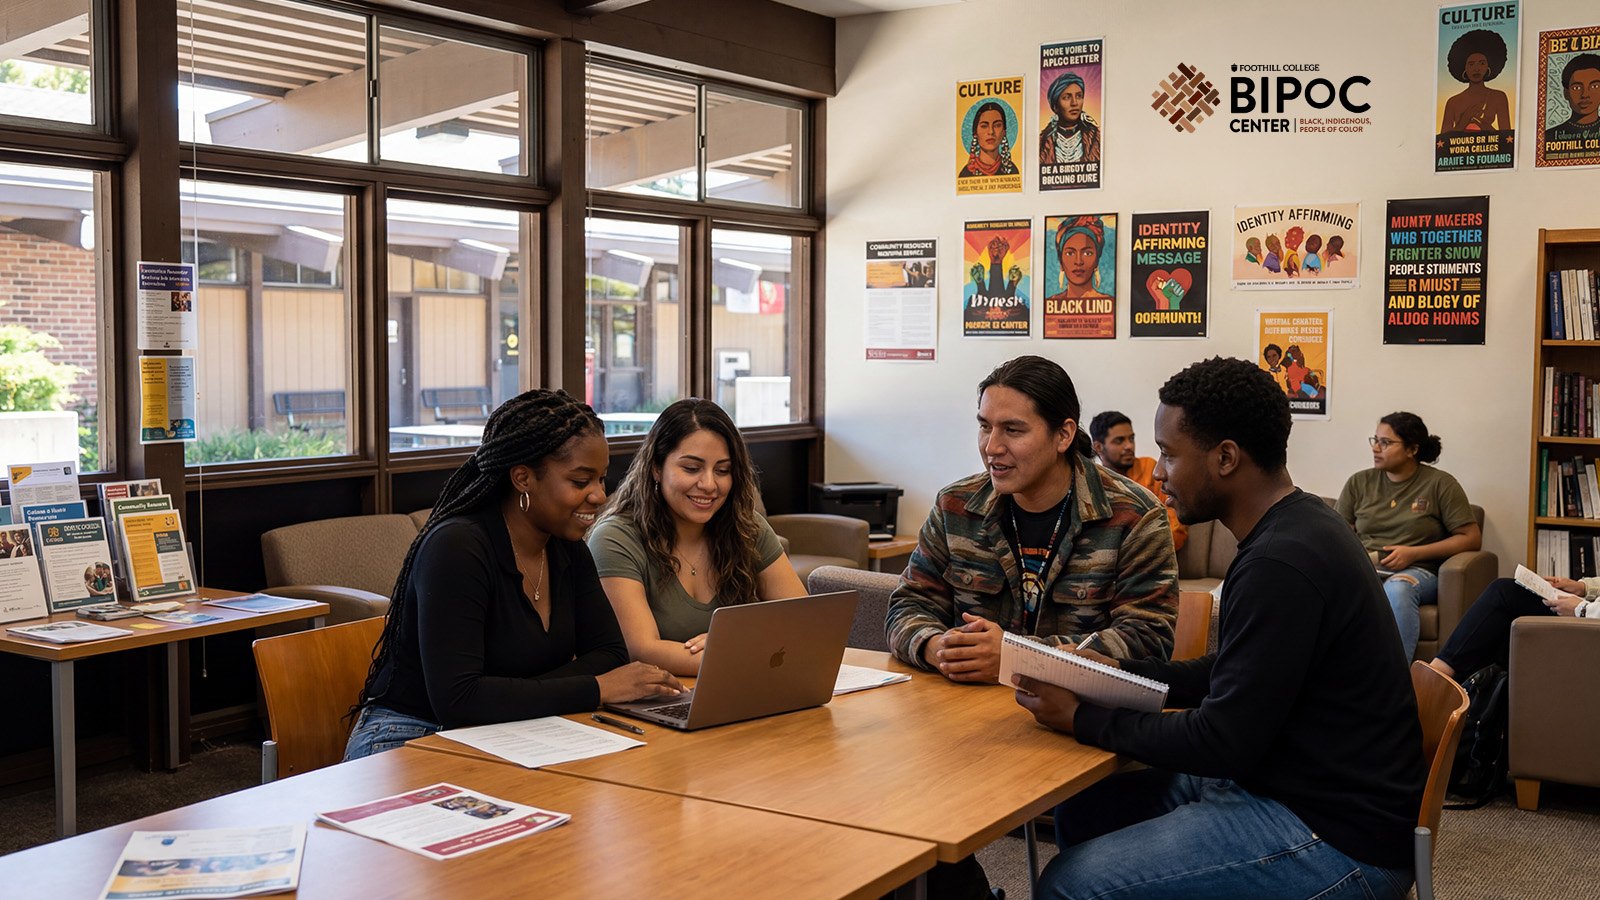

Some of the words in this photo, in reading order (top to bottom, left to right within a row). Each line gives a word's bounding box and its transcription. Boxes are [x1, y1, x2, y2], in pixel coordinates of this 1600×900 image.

[1441, 4, 1516, 25] CULTURE
[1043, 47, 1064, 57] MORE
[1089, 43, 1100, 52] TO
[1239, 64, 1281, 72] FOOTHILL
[1283, 64, 1320, 72] COLLEGE
[959, 79, 1022, 98] CULTURE
[1230, 118, 1290, 133] CENTER
[1299, 118, 1325, 126] BLACK,
[1325, 118, 1372, 126] INDIGENOUS,
[1545, 140, 1583, 152] FOOTHILL
[1466, 155, 1475, 165] IS
[1052, 165, 1058, 174] A
[1236, 209, 1284, 234] IDENTITY
[1138, 222, 1201, 236] IDENTITY
[1132, 236, 1206, 251] AFFIRMING
[1420, 229, 1483, 244] TOGETHER
[1136, 251, 1202, 265] MESSAGE
[1444, 246, 1482, 260] SNOW
[1389, 264, 1424, 276] PEOPLE
[1408, 278, 1417, 292] R
[1419, 278, 1460, 292] MIUST
[1046, 300, 1083, 314] BLACK
[1086, 298, 1113, 314] LIND
[1388, 295, 1415, 309] AND
[1462, 294, 1481, 308] OF
[1433, 311, 1480, 326] HONMS
